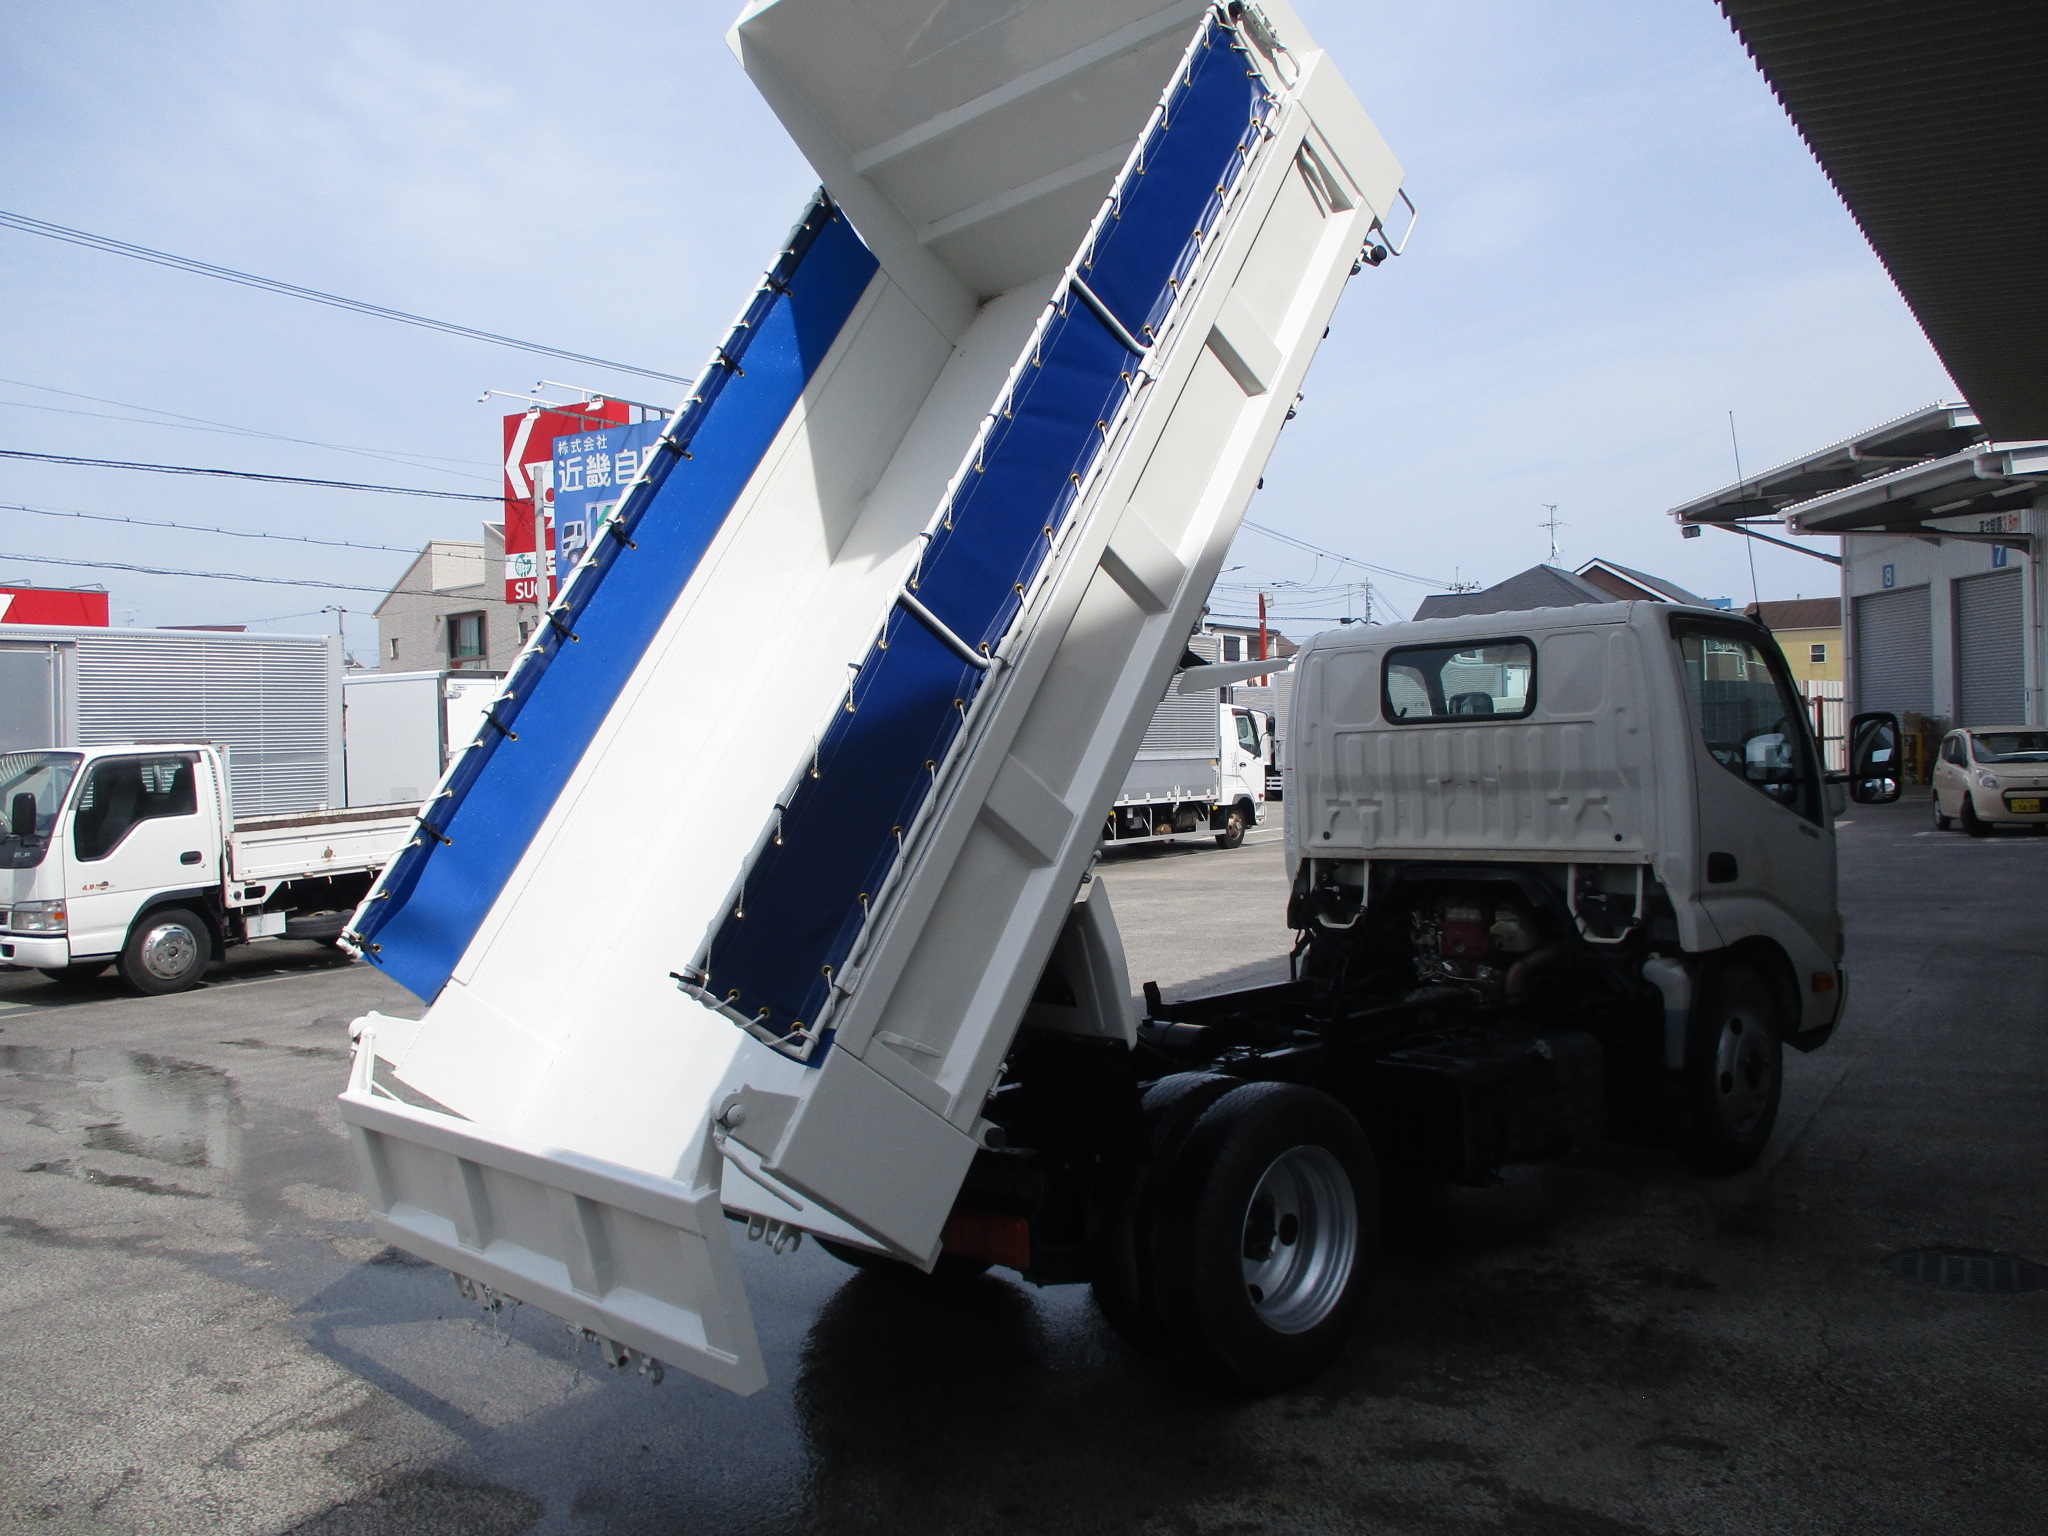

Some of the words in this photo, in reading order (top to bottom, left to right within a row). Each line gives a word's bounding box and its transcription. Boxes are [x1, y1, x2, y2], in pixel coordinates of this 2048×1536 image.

[557, 434, 608, 456] 株式会社
[558, 445, 655, 494] 近畿自
[1995, 544, 2004, 565] 7
[1884, 567, 1893, 586] 8
[514, 579, 551, 600] SUI
